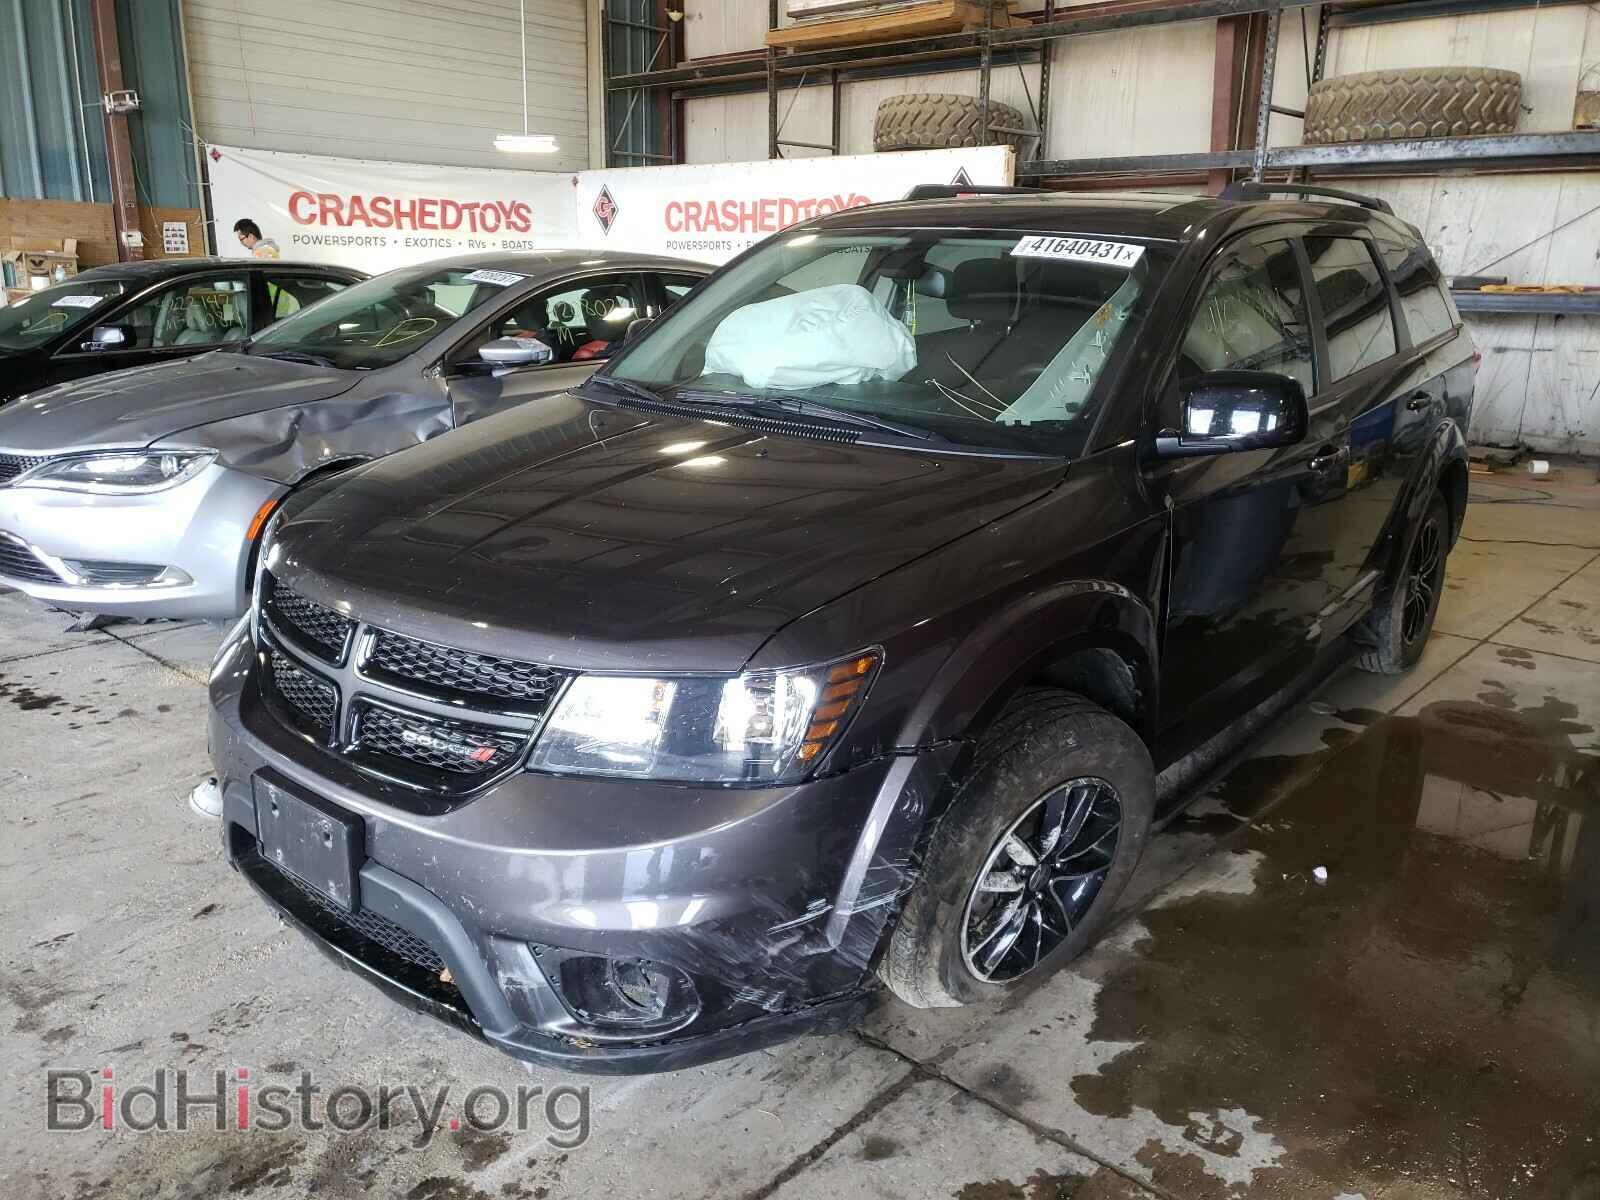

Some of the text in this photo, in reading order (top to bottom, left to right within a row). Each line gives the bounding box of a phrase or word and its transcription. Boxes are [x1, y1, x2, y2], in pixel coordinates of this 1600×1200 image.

[288, 191, 533, 233] CRASHEDTOYS
[292, 234, 534, 250] POWERSPORTS EXOTICS RVs BOATS
[666, 240, 732, 251] POWERSPORTS
